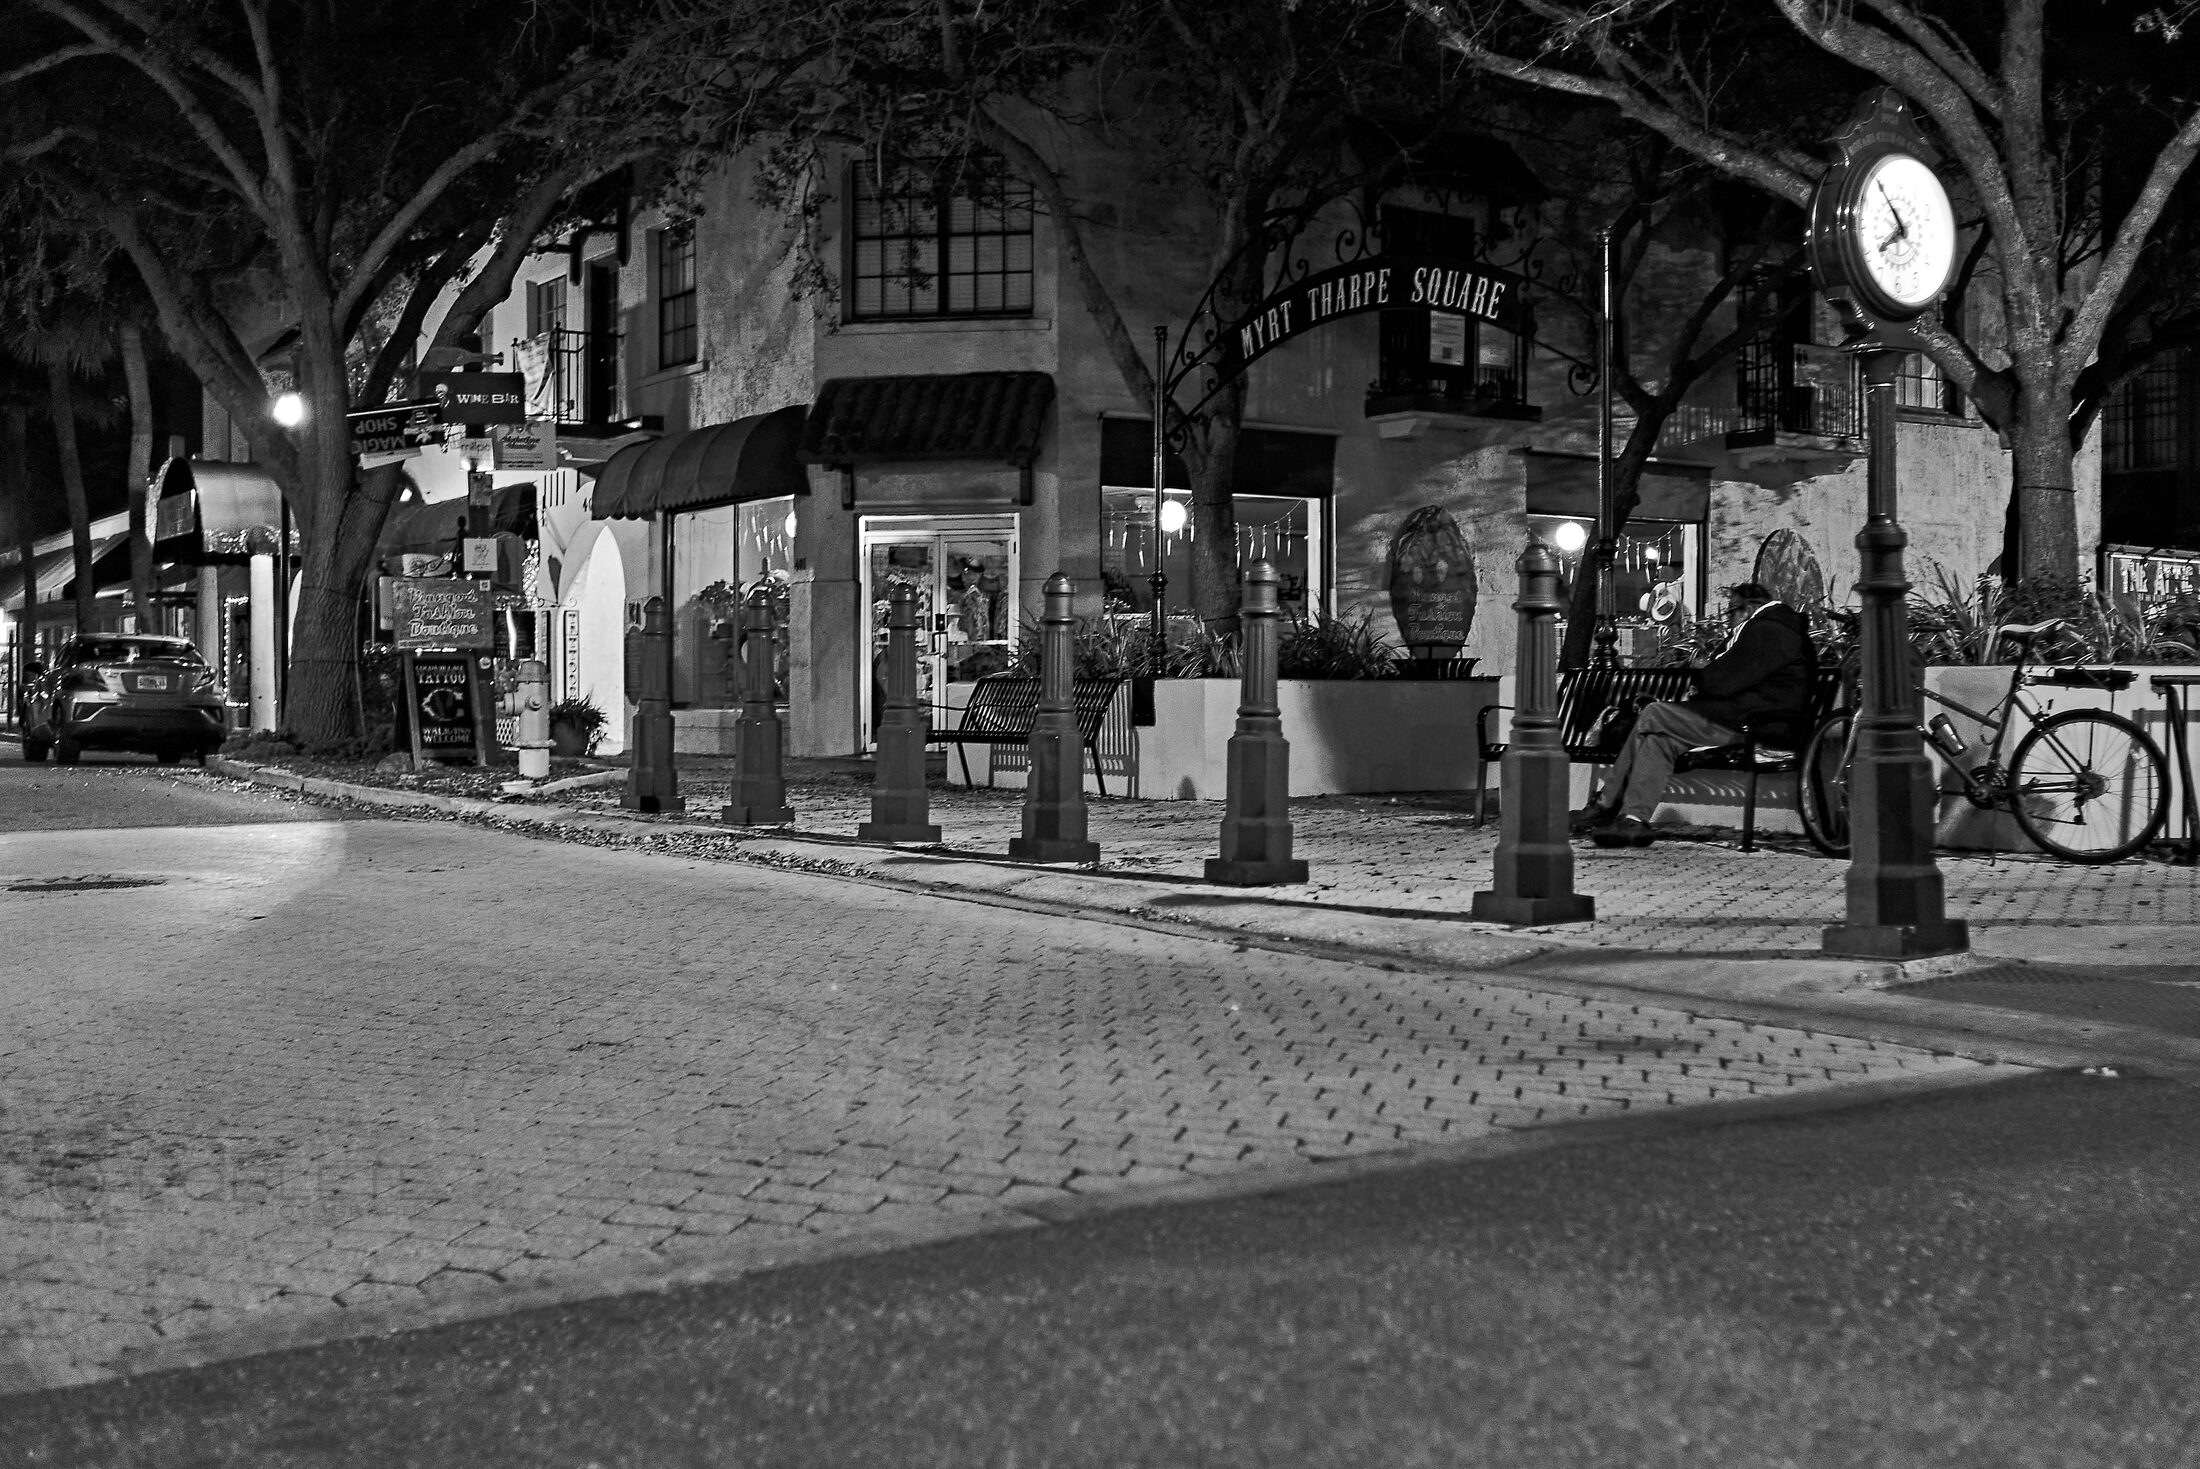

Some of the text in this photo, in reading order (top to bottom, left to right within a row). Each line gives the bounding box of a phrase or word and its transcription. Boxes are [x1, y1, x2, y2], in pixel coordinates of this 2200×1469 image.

[1240, 267, 1507, 360] MYRT THARPE SQUARE
[455, 393, 520, 404] WINE BAR
[354, 416, 398, 435] SHOP
[351, 435, 407, 455] MAGIC
[2118, 559, 2148, 593] THE
[412, 603, 476, 620] Fashion
[408, 619, 479, 638] Boutique
[417, 673, 467, 685] TATTOO
